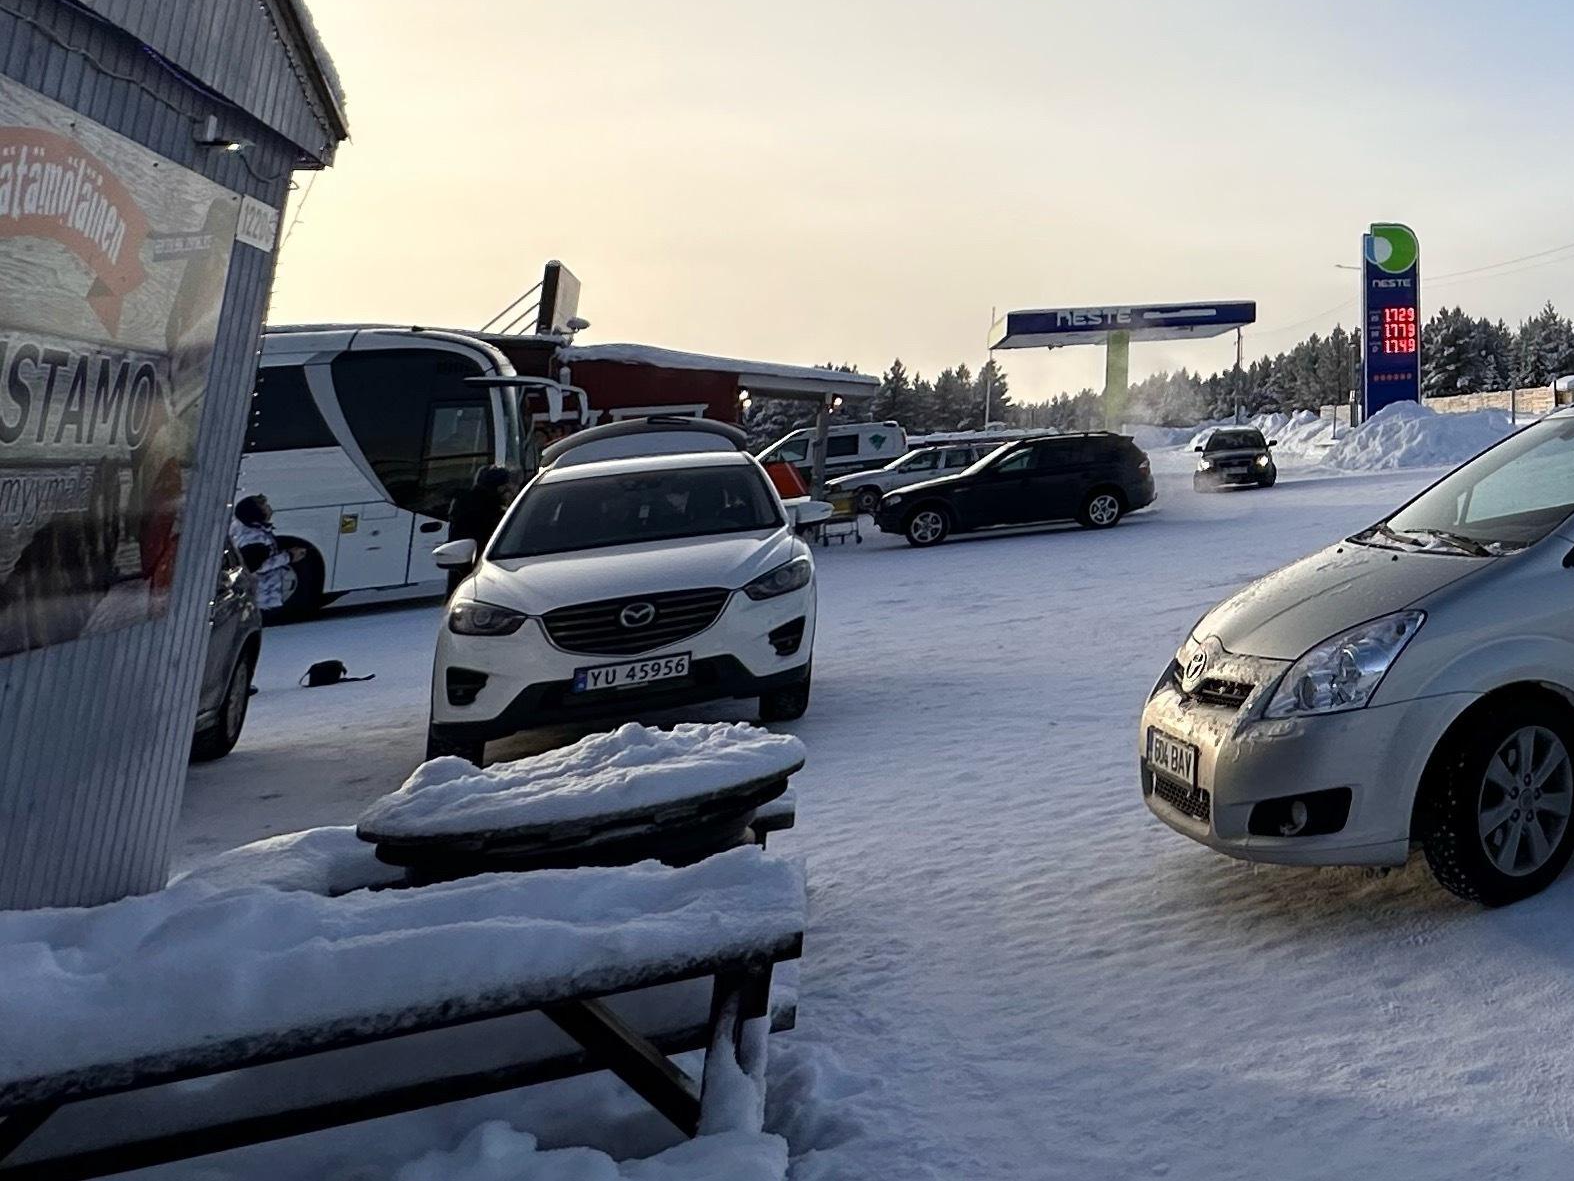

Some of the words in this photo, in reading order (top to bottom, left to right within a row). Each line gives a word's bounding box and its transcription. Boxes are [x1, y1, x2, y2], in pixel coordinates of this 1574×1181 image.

[1372, 279, 1412, 288] NESTE
[1056, 308, 1132, 327] NESTE
[0, 340, 156, 450] STAMO
[591, 669, 617, 686] YU
[626, 658, 686, 681] 45956
